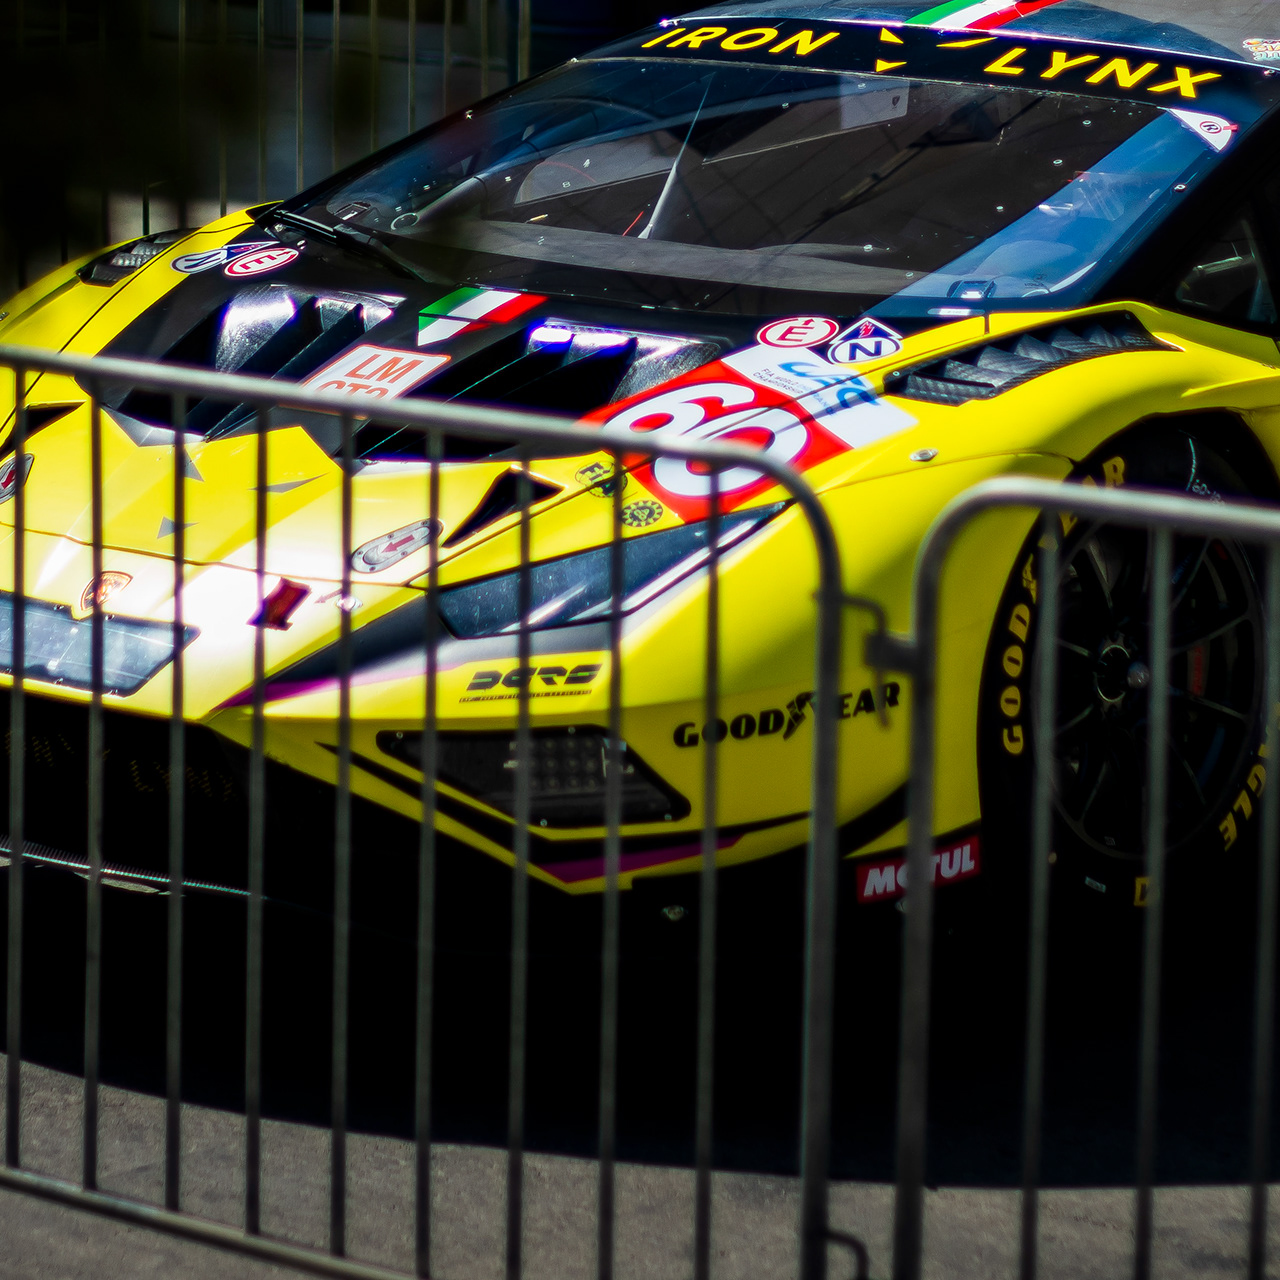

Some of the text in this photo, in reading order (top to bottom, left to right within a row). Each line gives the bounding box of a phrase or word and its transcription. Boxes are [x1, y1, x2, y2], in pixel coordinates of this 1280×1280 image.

[641, 26, 1222, 98] IRON LYNX
[345, 353, 424, 384] LM
[603, 380, 812, 497] 60
[673, 682, 900, 748] GOODEAR
